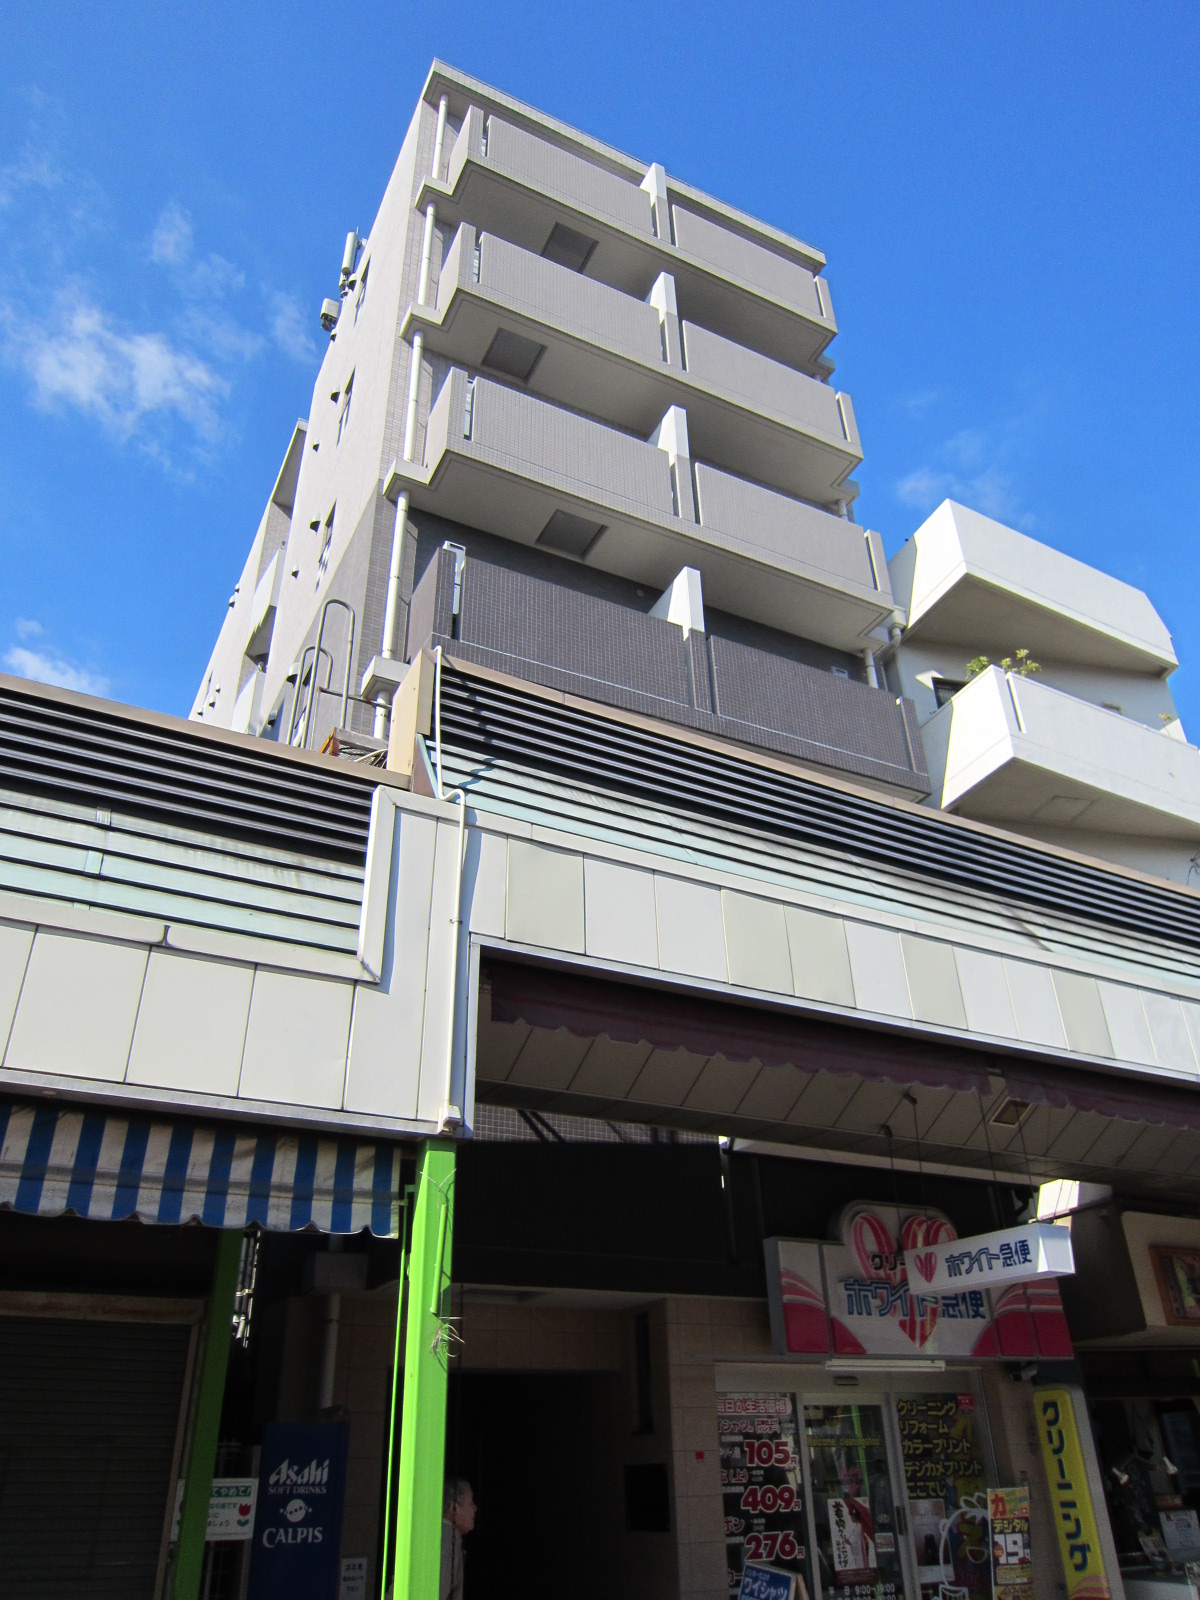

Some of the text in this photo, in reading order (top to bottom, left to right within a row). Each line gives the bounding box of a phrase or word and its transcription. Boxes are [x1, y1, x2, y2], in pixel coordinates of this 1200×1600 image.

[945, 1239, 1033, 1277] ホワイト急便
[844, 1277, 987, 1319] ホワイト急便
[898, 1399, 957, 1417] クリーニング
[899, 1418, 950, 1435] リフォーム
[903, 1438, 972, 1455] カラープリント
[268, 1458, 330, 1485] Asahi
[904, 1460, 983, 1478] デジカメプリント
[267, 1484, 327, 1495] SOFT DRINKS
[1042, 1401, 1091, 1572] クリーニング
[262, 1527, 324, 1549] CALPIS
